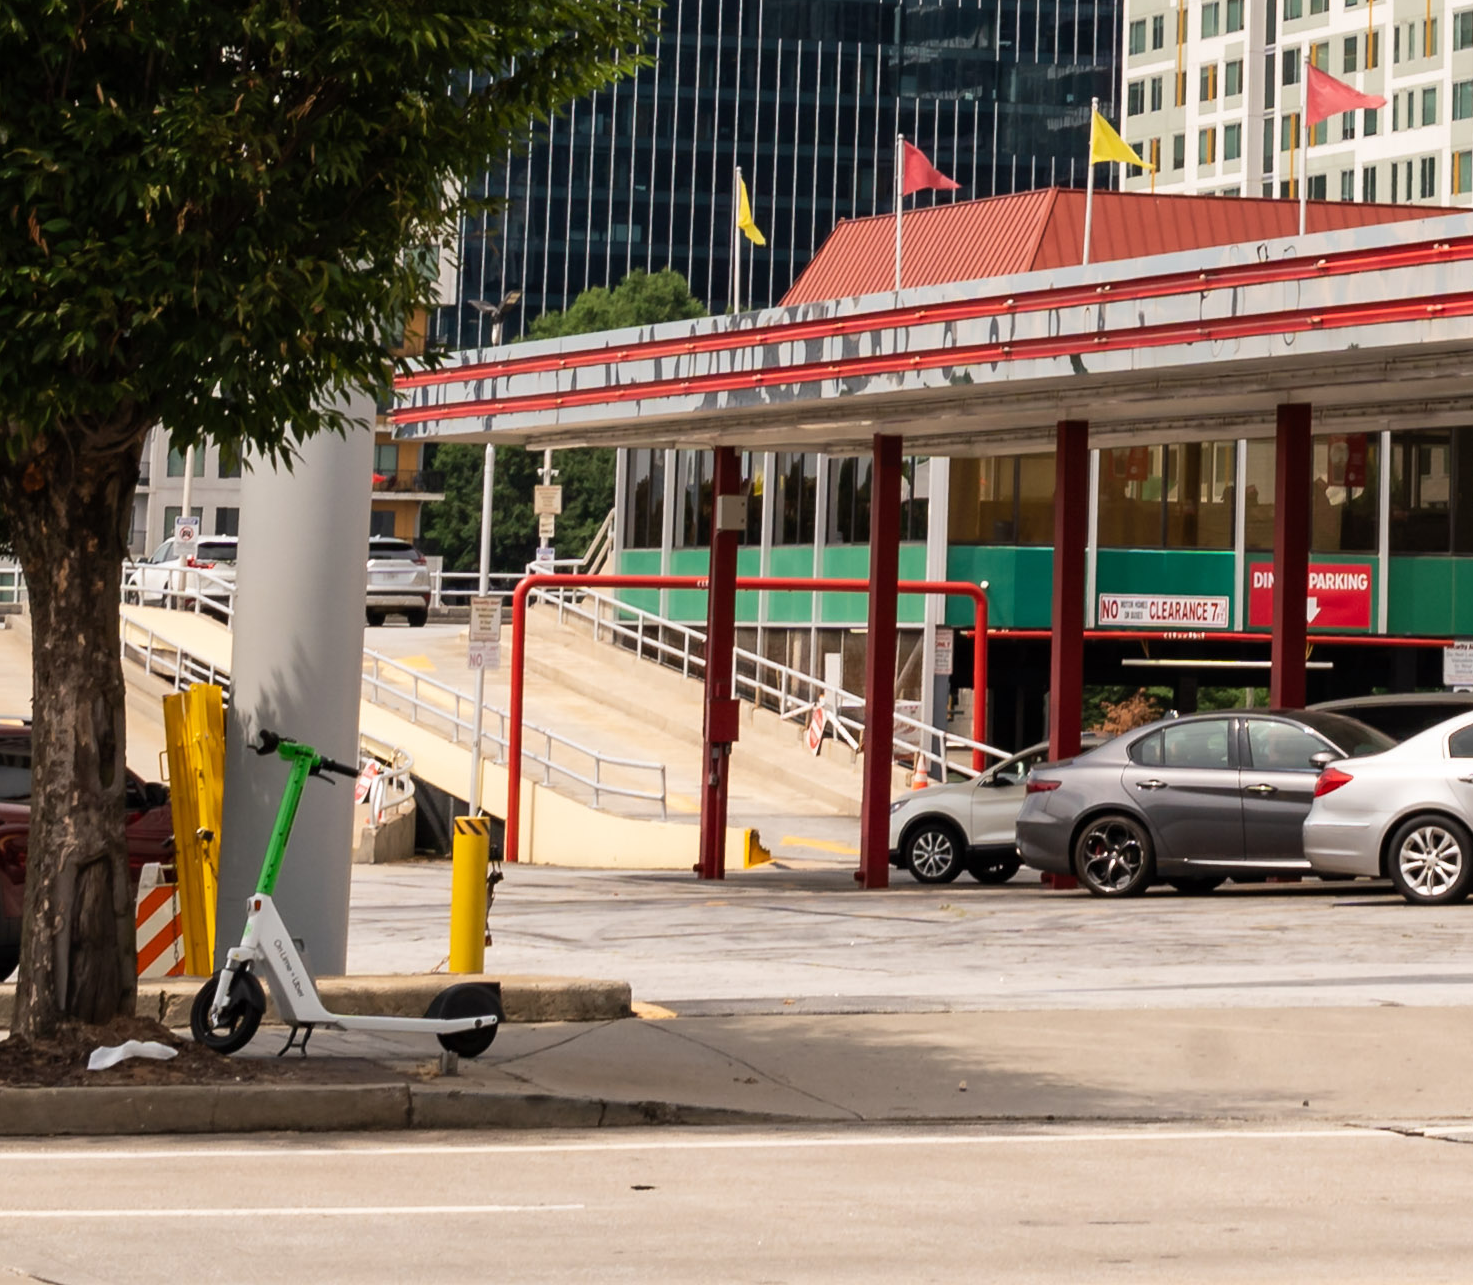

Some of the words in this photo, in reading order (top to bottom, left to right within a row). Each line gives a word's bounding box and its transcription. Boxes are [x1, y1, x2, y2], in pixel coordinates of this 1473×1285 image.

[1308, 573, 1368, 591] PARKING
[1102, 600, 1119, 619] NO
[1149, 600, 1208, 621] CLEARANCE
[469, 653, 483, 667] NO
